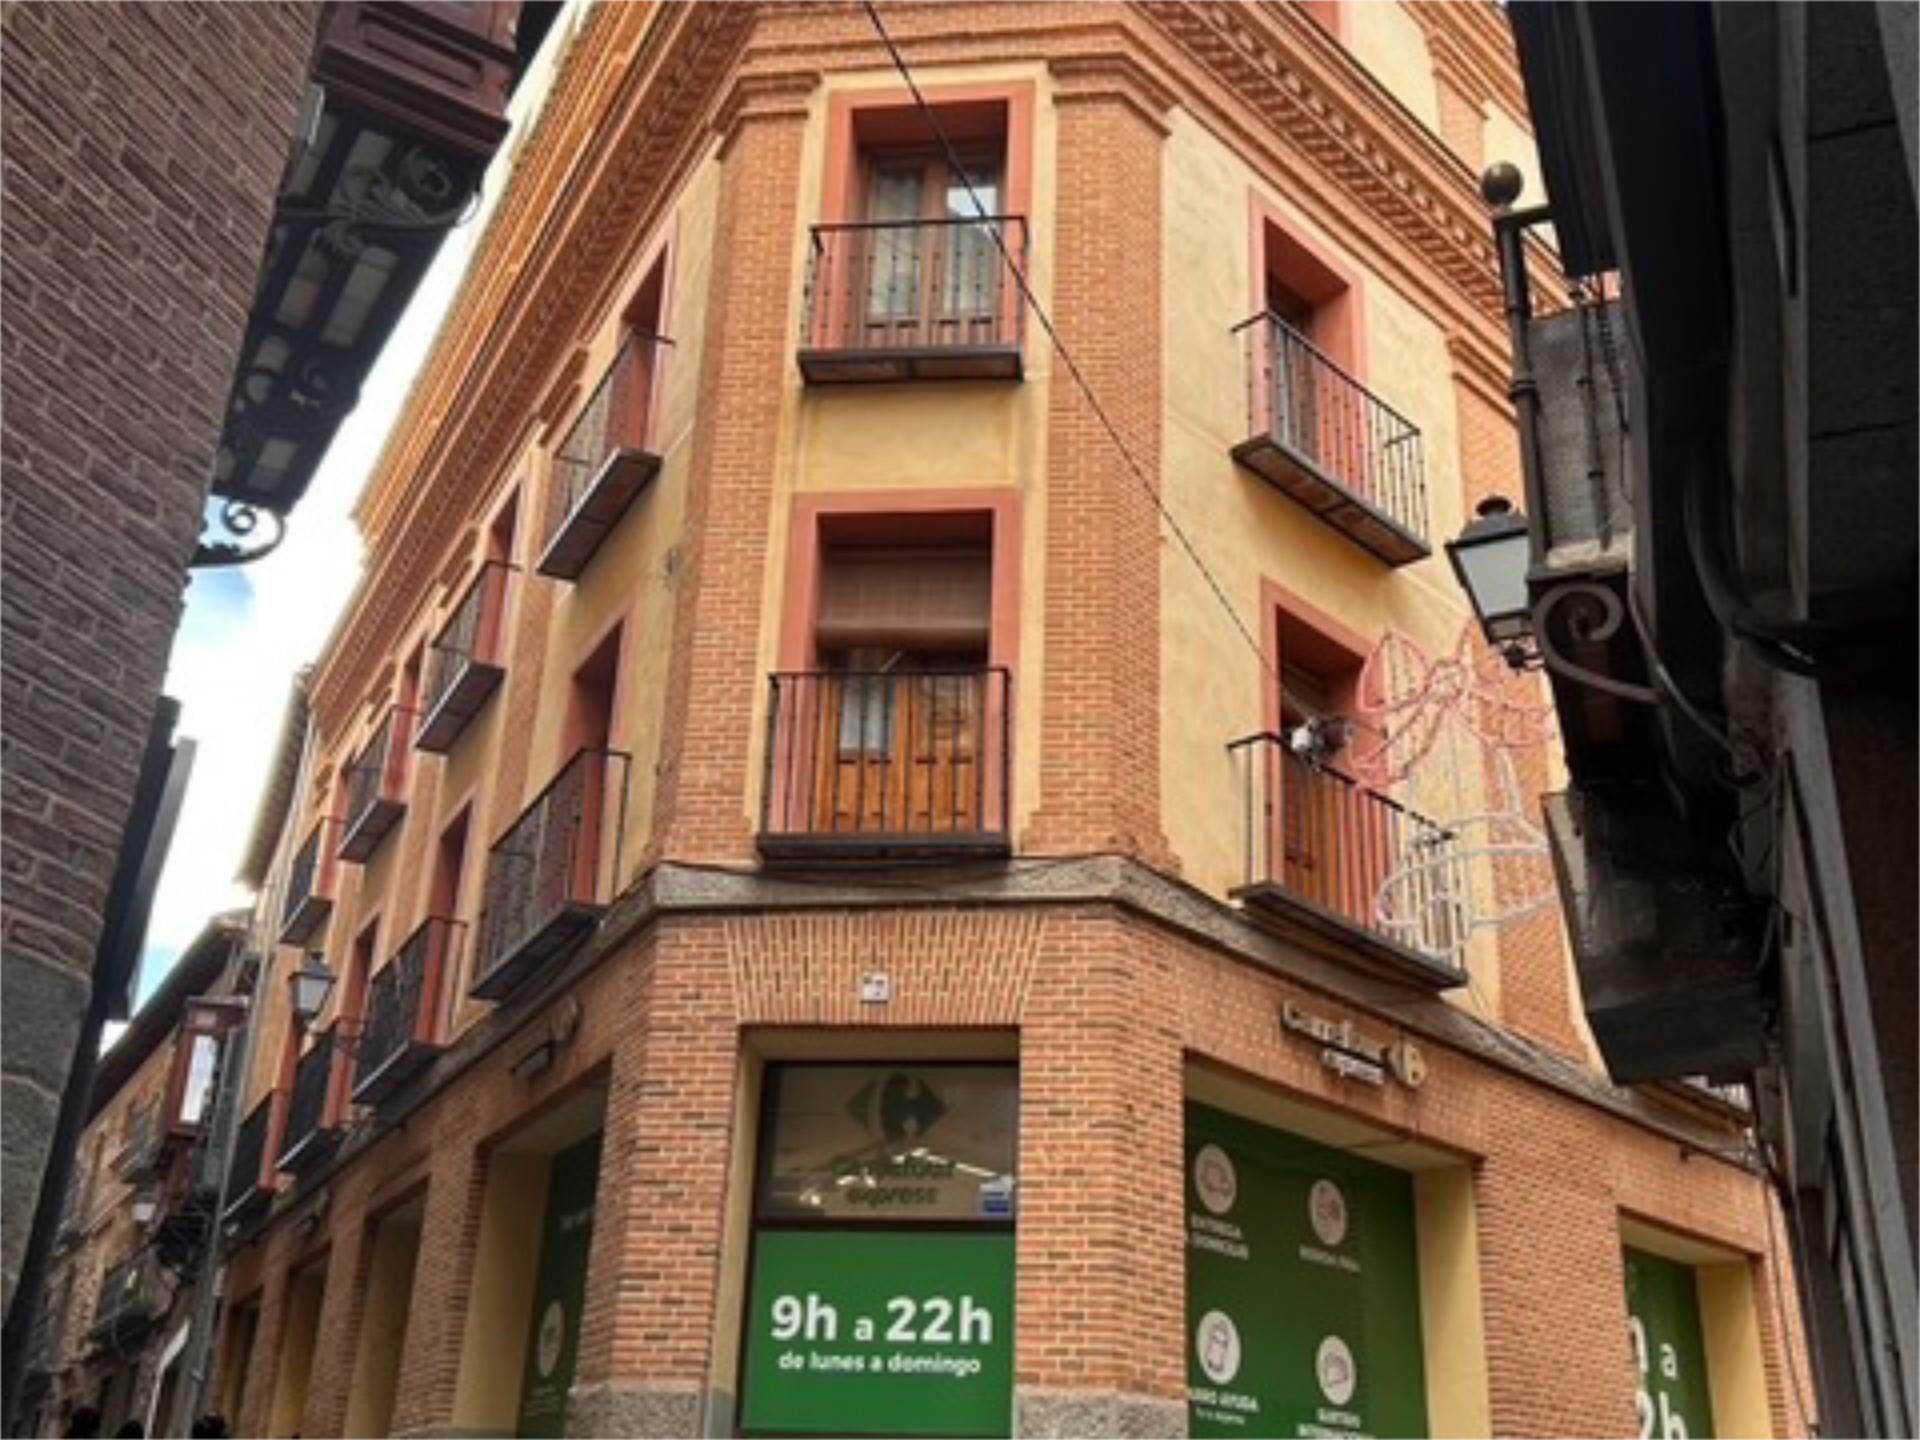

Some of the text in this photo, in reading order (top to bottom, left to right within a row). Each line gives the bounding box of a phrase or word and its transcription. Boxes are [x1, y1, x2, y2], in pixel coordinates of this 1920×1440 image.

[771, 1293, 993, 1344] 9h a 22h
[778, 1351, 981, 1377] de lunes a domingo
